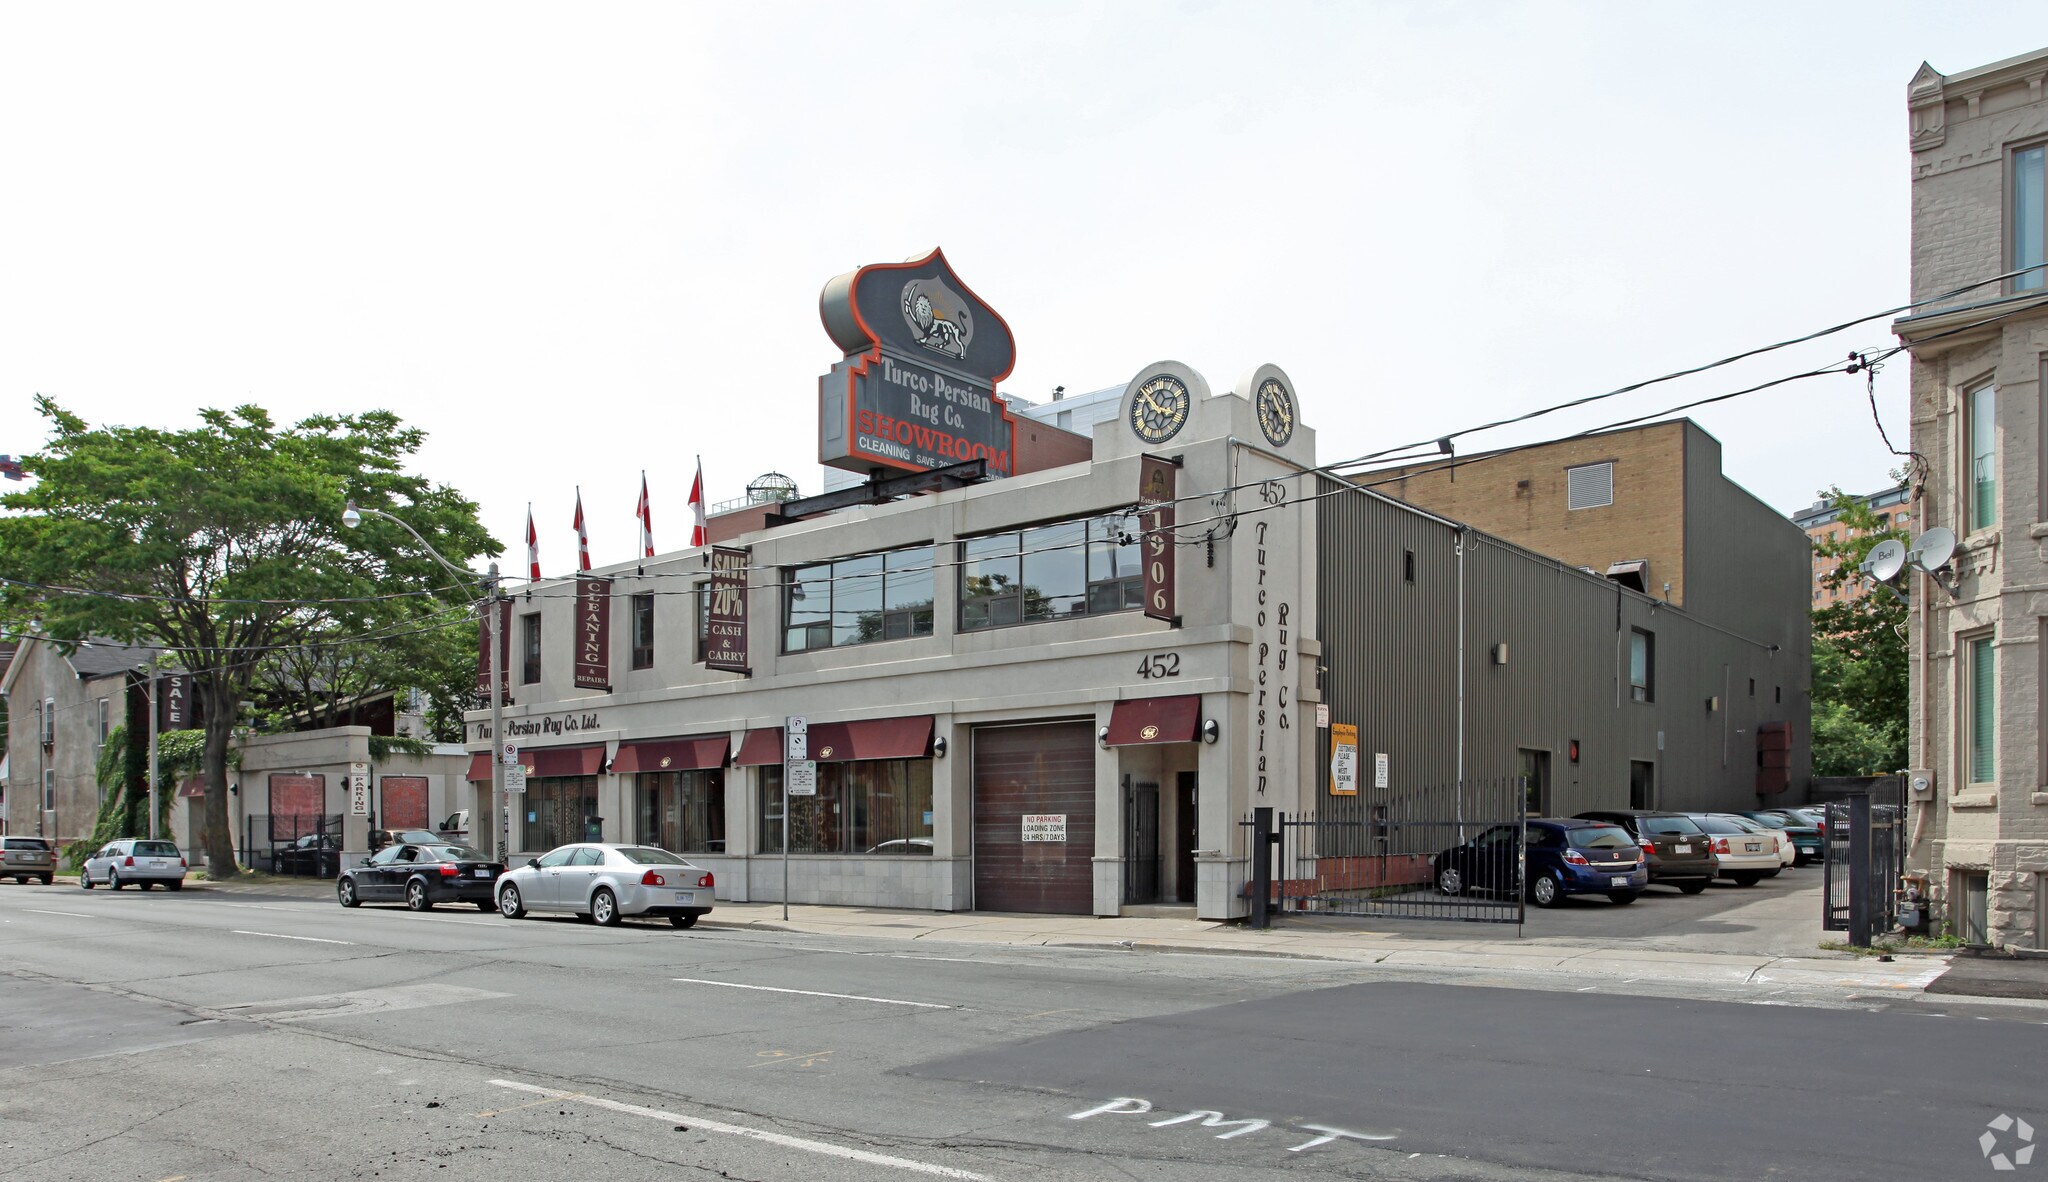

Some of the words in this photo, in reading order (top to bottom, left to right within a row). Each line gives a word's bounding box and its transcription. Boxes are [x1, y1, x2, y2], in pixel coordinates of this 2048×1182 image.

[881, 358, 991, 414] Turco-Persian
[910, 393, 939, 425] Rug
[944, 405, 965, 429] Co.
[858, 408, 1008, 472] SHOWROOM
[859, 436, 910, 460] CLEANING
[916, 454, 935, 467] SAVE
[1259, 481, 1287, 508] 452
[714, 553, 746, 580] SAVE
[1150, 511, 1167, 610] 1906
[1878, 548, 1895, 560] Bell
[1255, 521, 1268, 627] Turco
[713, 582, 743, 616] 20%
[584, 582, 600, 662] CLEANING
[712, 625, 742, 636] CASH
[1278, 602, 1290, 671] Rug
[708, 651, 746, 662] CARRY
[722, 639, 731, 648] &
[577, 675, 607, 684] REPAIRS
[1137, 652, 1180, 679] 452
[169, 677, 182, 722] SALE
[1279, 685, 1290, 730] Co.
[543, 716, 562, 735] Rug
[564, 714, 578, 731] Co.
[581, 713, 600, 730] Ltd.
[1257, 642, 1269, 796] Persian
[355, 777, 364, 811] PARKING
[1027, 815, 1035, 823] NO
[1036, 815, 1062, 823] PARKING
